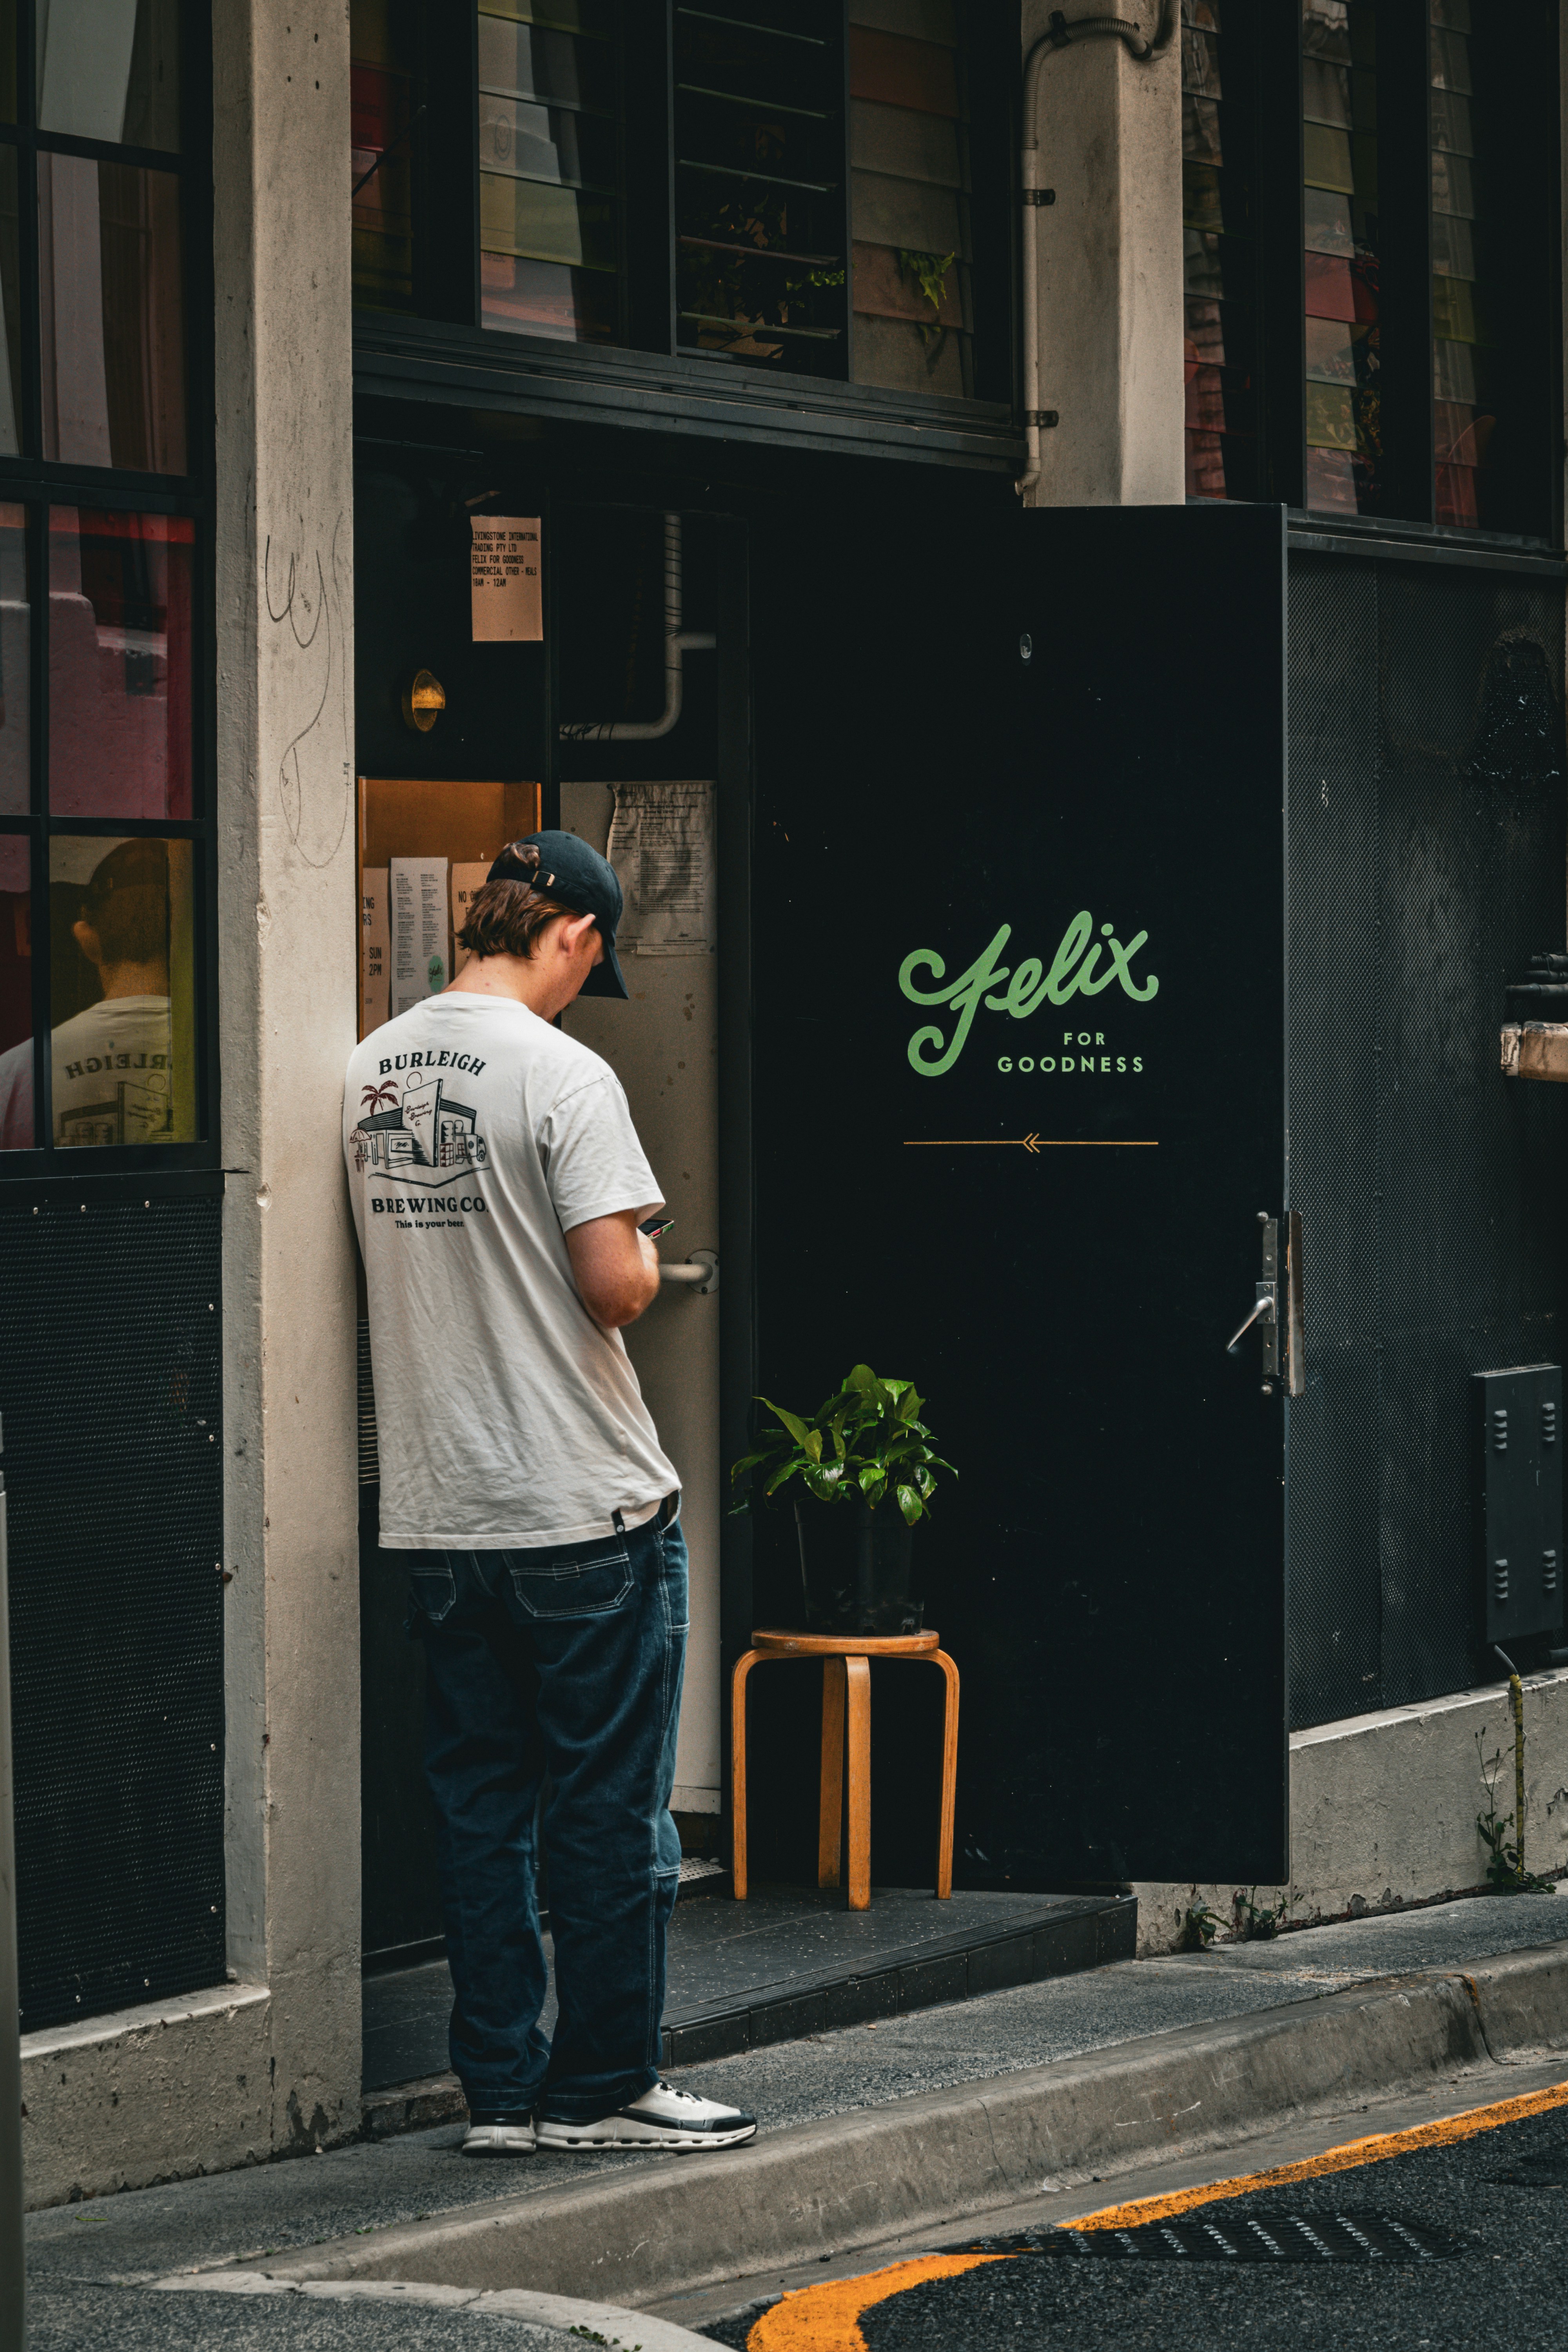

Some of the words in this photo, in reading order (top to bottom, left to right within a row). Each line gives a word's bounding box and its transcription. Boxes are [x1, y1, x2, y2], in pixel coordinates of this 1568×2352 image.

[472, 531, 506, 541] LIVINGSTONE
[509, 532, 538, 541] INTERNATIONAL
[472, 543, 493, 552] TRADING
[496, 543, 506, 552] PTY
[508, 543, 517, 552] LTD
[472, 555, 486, 564] FELIX
[490, 555, 500, 564] FOR
[503, 555, 524, 564] GOODNESS
[472, 566, 503, 575] COMMERCIAL
[506, 566, 519, 575] OTHER
[525, 567, 537, 576] MEALS
[493, 578, 506, 587] 12AM
[363, 897, 375, 909] ING
[458, 891, 466, 903] NO
[363, 913, 372, 926] RS
[369, 947, 382, 959] SUN
[369, 964, 382, 976] 2PM
[898, 910, 1159, 1077] Felix
[1064, 1032, 1105, 1045] FOR
[379, 1051, 486, 1076] BURLEIGH
[998, 1056, 1143, 1073] GOODNESS
[405, 1102, 429, 1114] Burleigh
[408, 1110, 432, 1120] Brewing
[372, 1198, 457, 1213] BREWING
[395, 1220, 412, 1228] This
[425, 1221, 446, 1229] your
[447, 1219, 465, 1227] beer.
